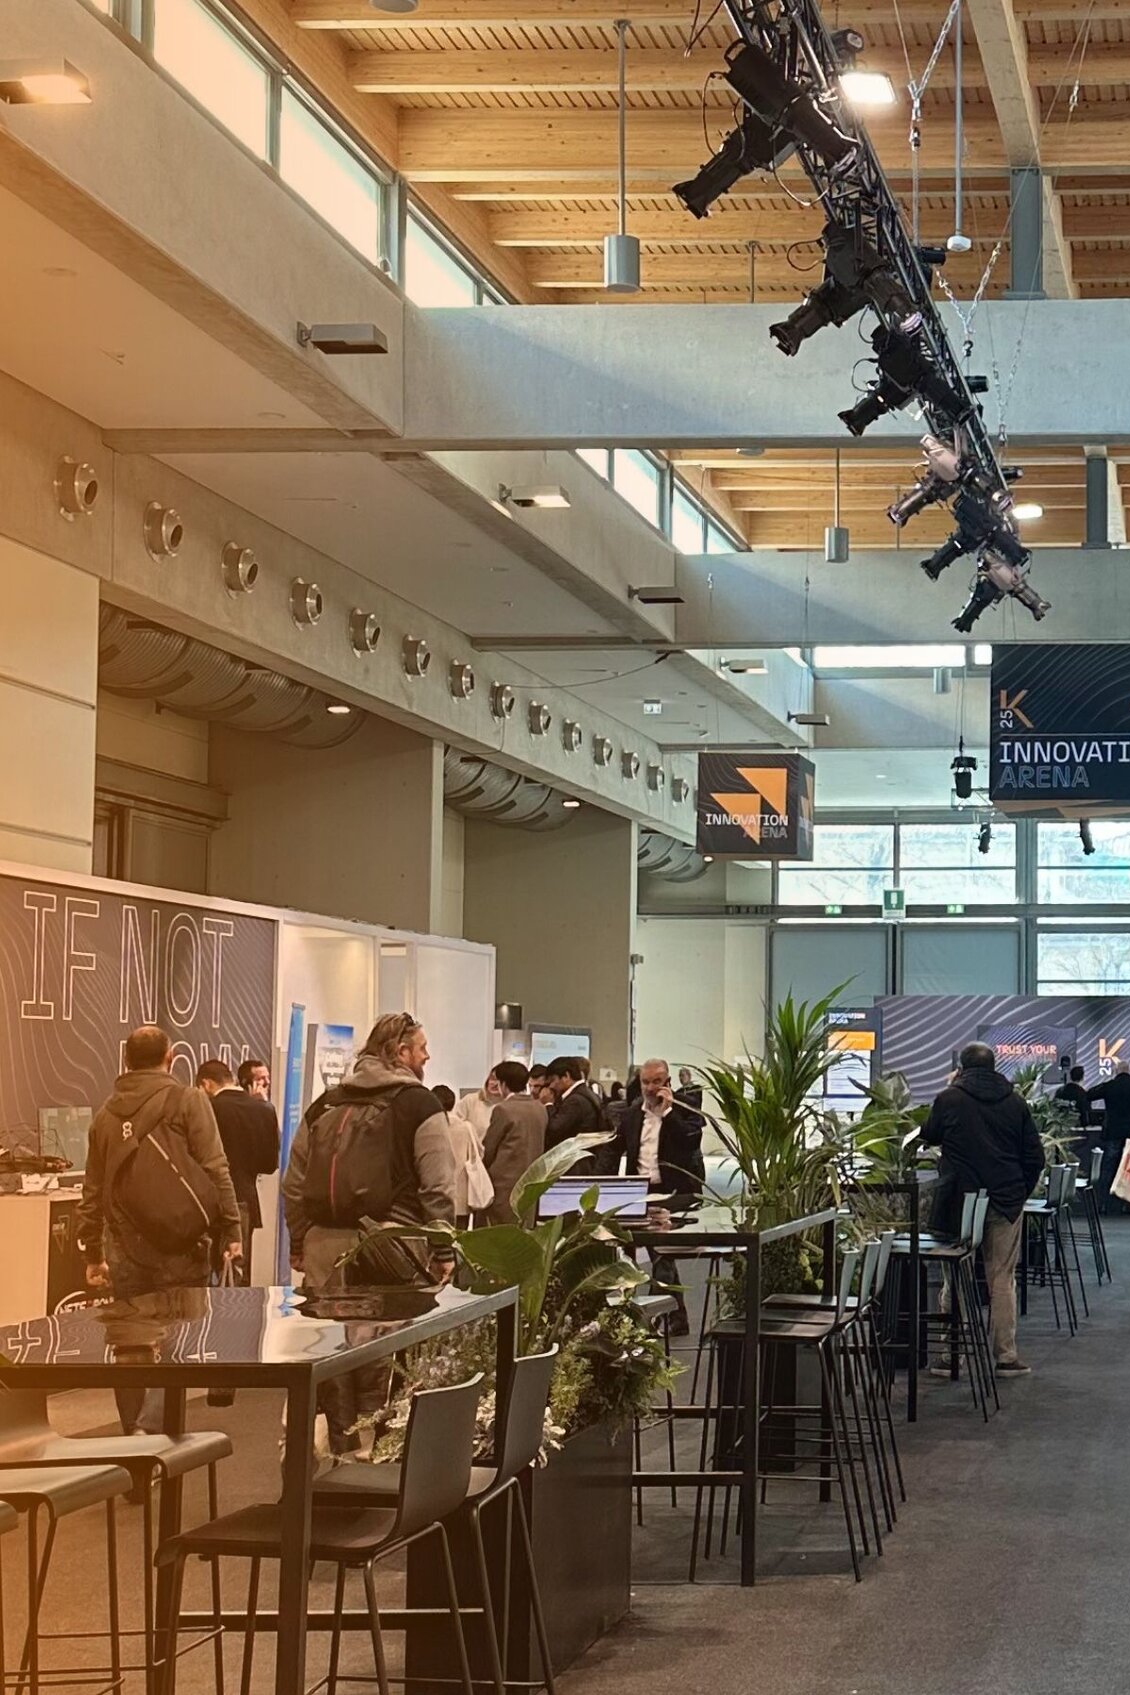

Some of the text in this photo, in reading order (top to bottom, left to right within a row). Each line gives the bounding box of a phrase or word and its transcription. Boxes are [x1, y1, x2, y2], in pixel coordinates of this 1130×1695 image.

[1000, 710, 1013, 729] 25
[999, 765, 1090, 789] ARENA
[705, 813, 789, 827] INNOVATION
[743, 826, 788, 839] ENA
[21, 890, 234, 1029] IF NOT
[996, 1044, 1058, 1056] TRUST YOUR
[1098, 1057, 1112, 1076] 25
